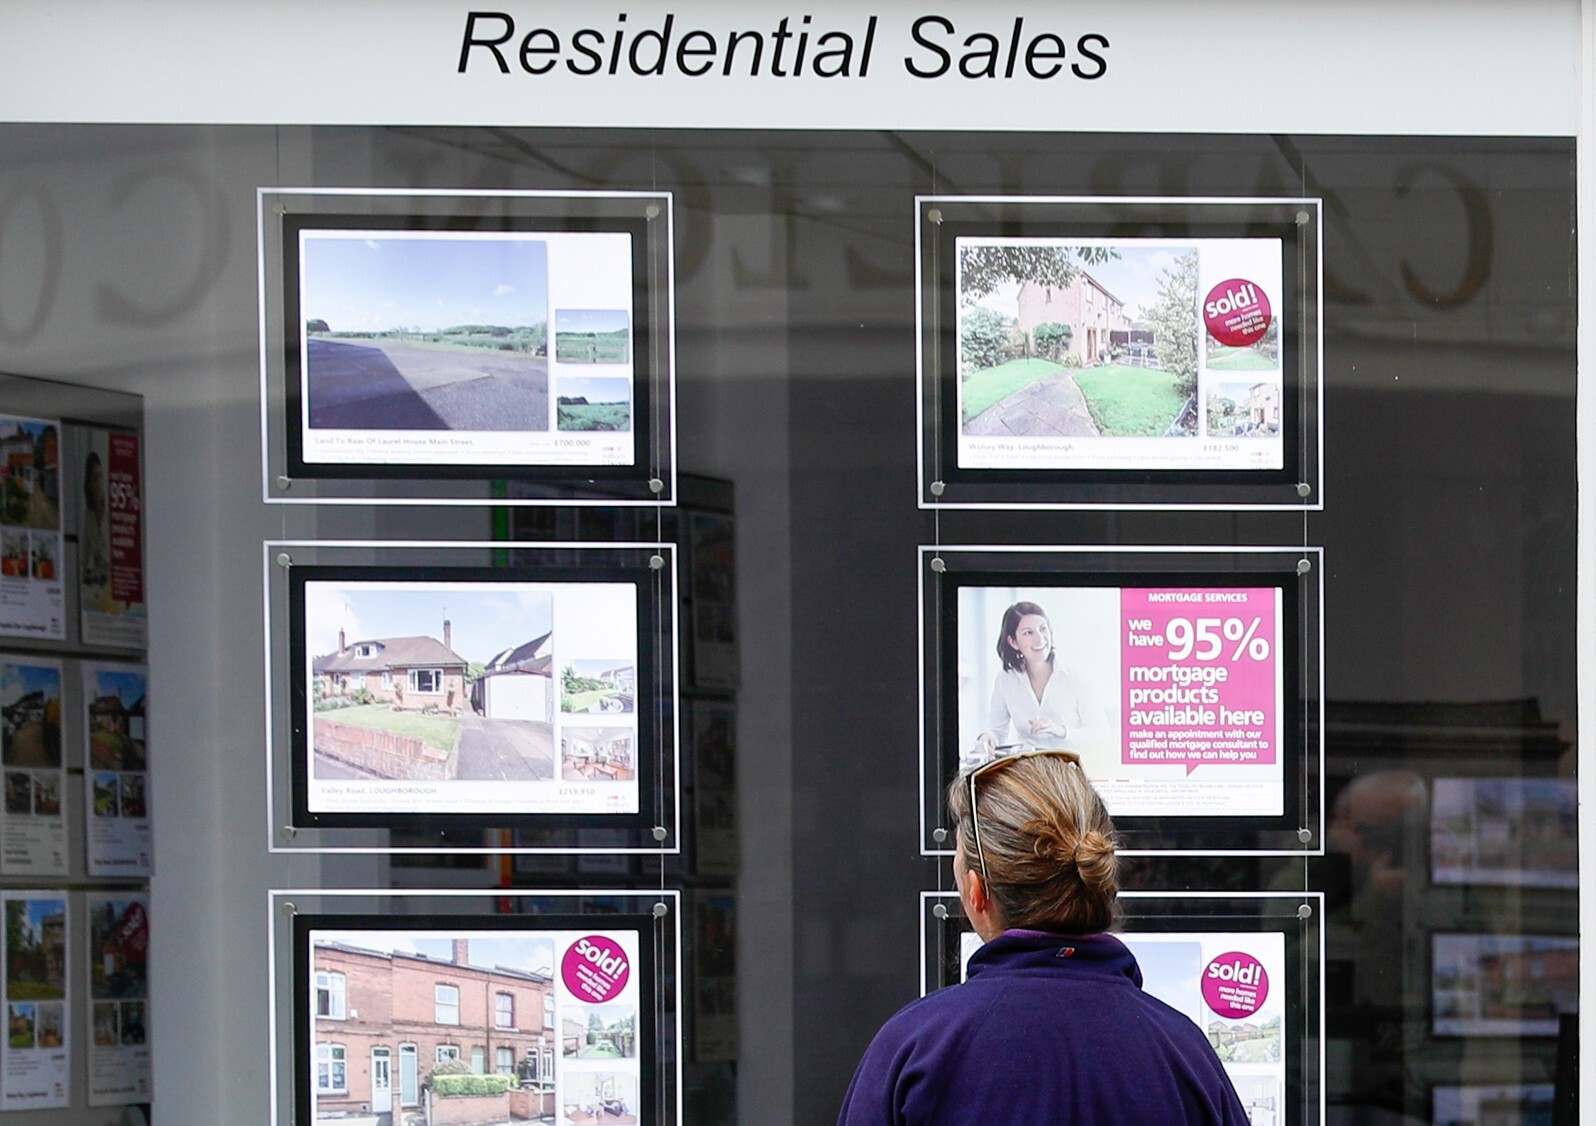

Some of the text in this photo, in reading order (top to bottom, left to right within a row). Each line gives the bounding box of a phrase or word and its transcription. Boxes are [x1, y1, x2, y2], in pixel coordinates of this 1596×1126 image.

[457, 11, 1112, 80] Residential Sales
[1206, 283, 1258, 318] sold!
[1148, 593, 1248, 602] MORTGAGE SERVICES
[1128, 619, 1152, 631] we
[1128, 617, 1270, 661] have 95%
[1129, 664, 1228, 687] mortgage
[1129, 684, 1219, 708] products
[1129, 705, 1265, 726] available here
[1129, 729, 1262, 741] make an appointment with our
[1129, 740, 1269, 751] qualified mortgage consultant to
[1129, 750, 1257, 761] find out how we can help you
[574, 939, 628, 980] sold!
[1208, 960, 1262, 986] sold!
